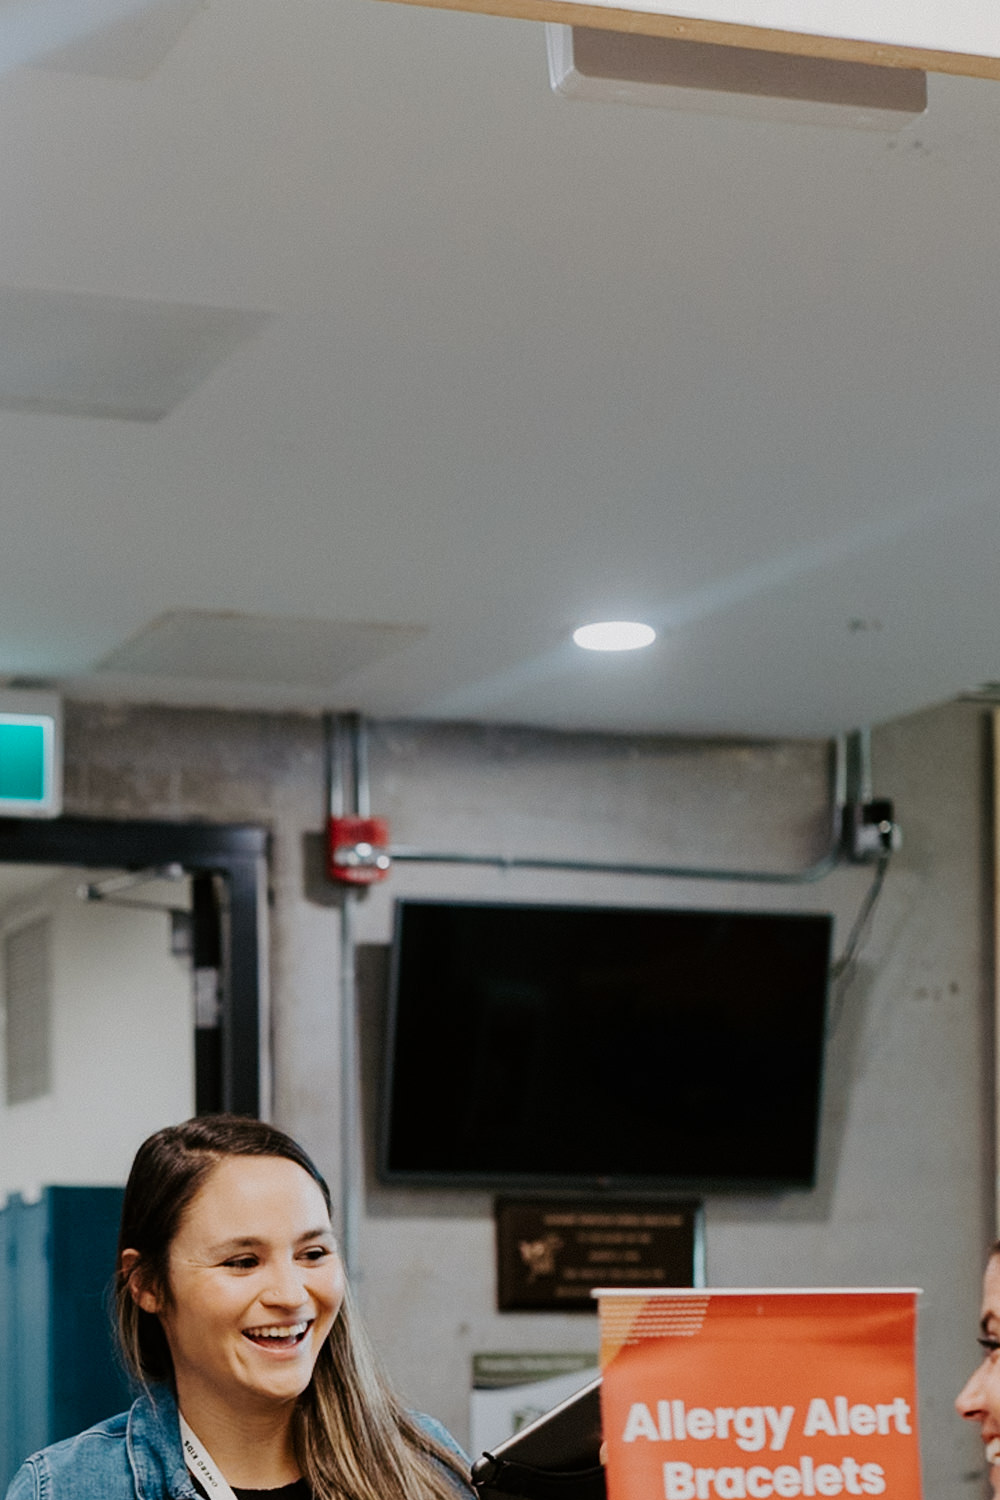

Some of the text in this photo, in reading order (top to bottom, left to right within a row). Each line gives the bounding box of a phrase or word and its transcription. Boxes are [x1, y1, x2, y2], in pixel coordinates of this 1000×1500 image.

[622, 1396, 912, 1452] Allergy Alert
[184, 1440, 198, 1460] KIDS
[663, 1456, 887, 1500] Bracelets
